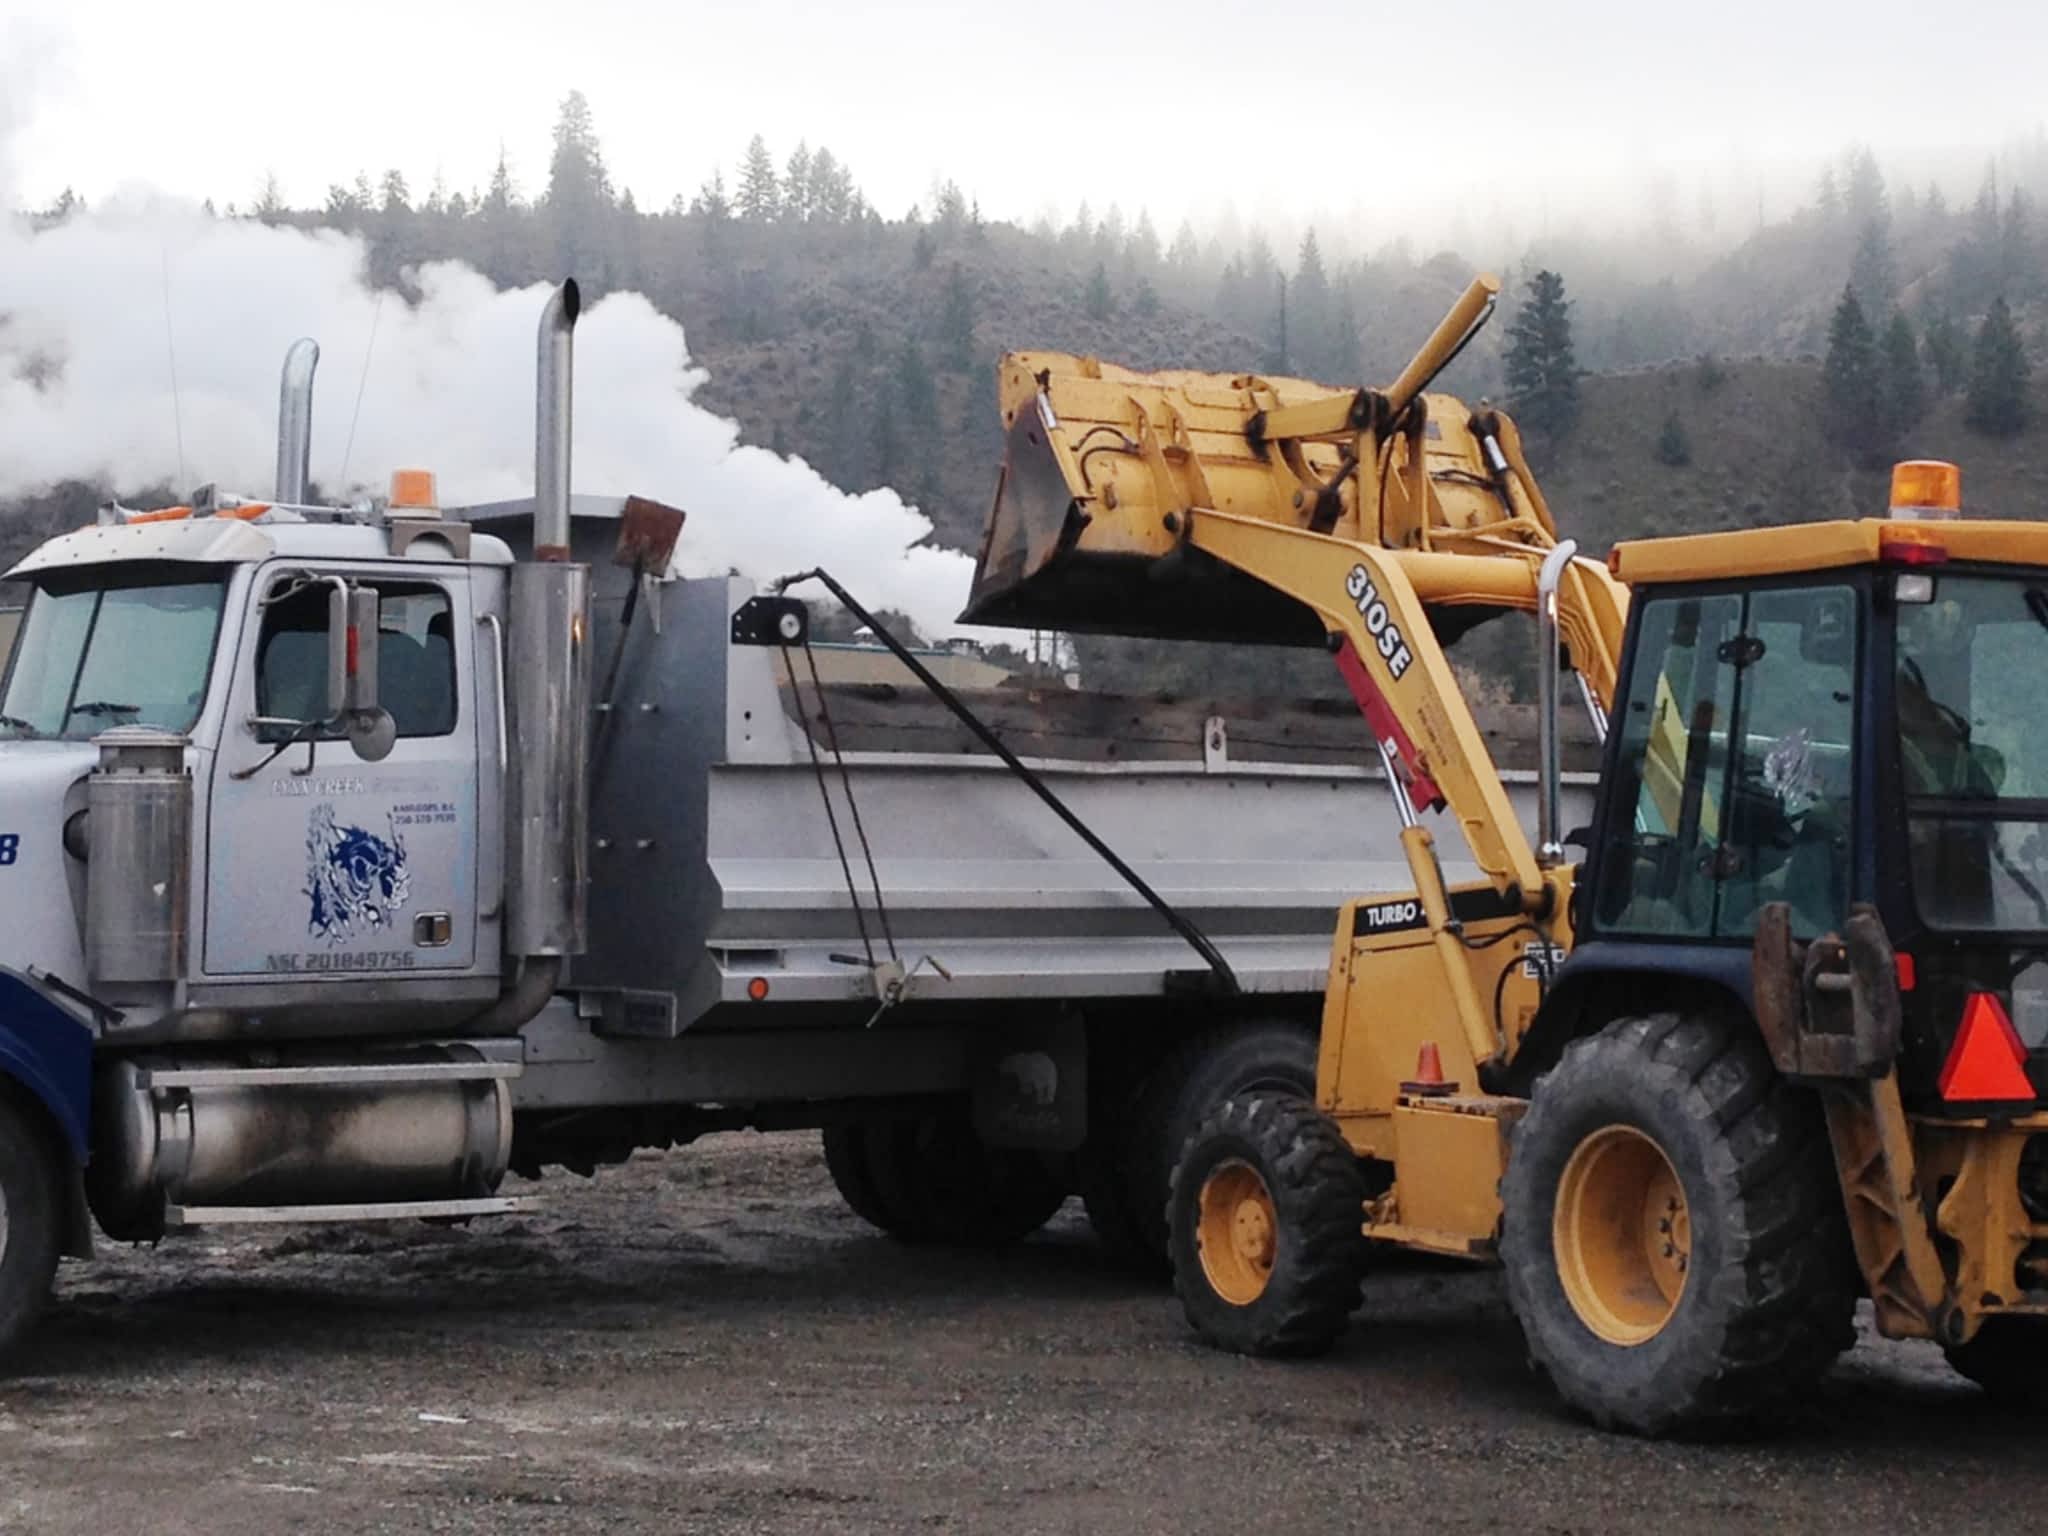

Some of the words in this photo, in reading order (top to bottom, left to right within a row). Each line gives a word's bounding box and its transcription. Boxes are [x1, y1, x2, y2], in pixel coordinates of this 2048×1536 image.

[1346, 563, 1413, 682] 310SE
[314, 777, 366, 794] CREEK
[0, 833, 19, 866] 8
[1367, 902, 1417, 927] TURBO
